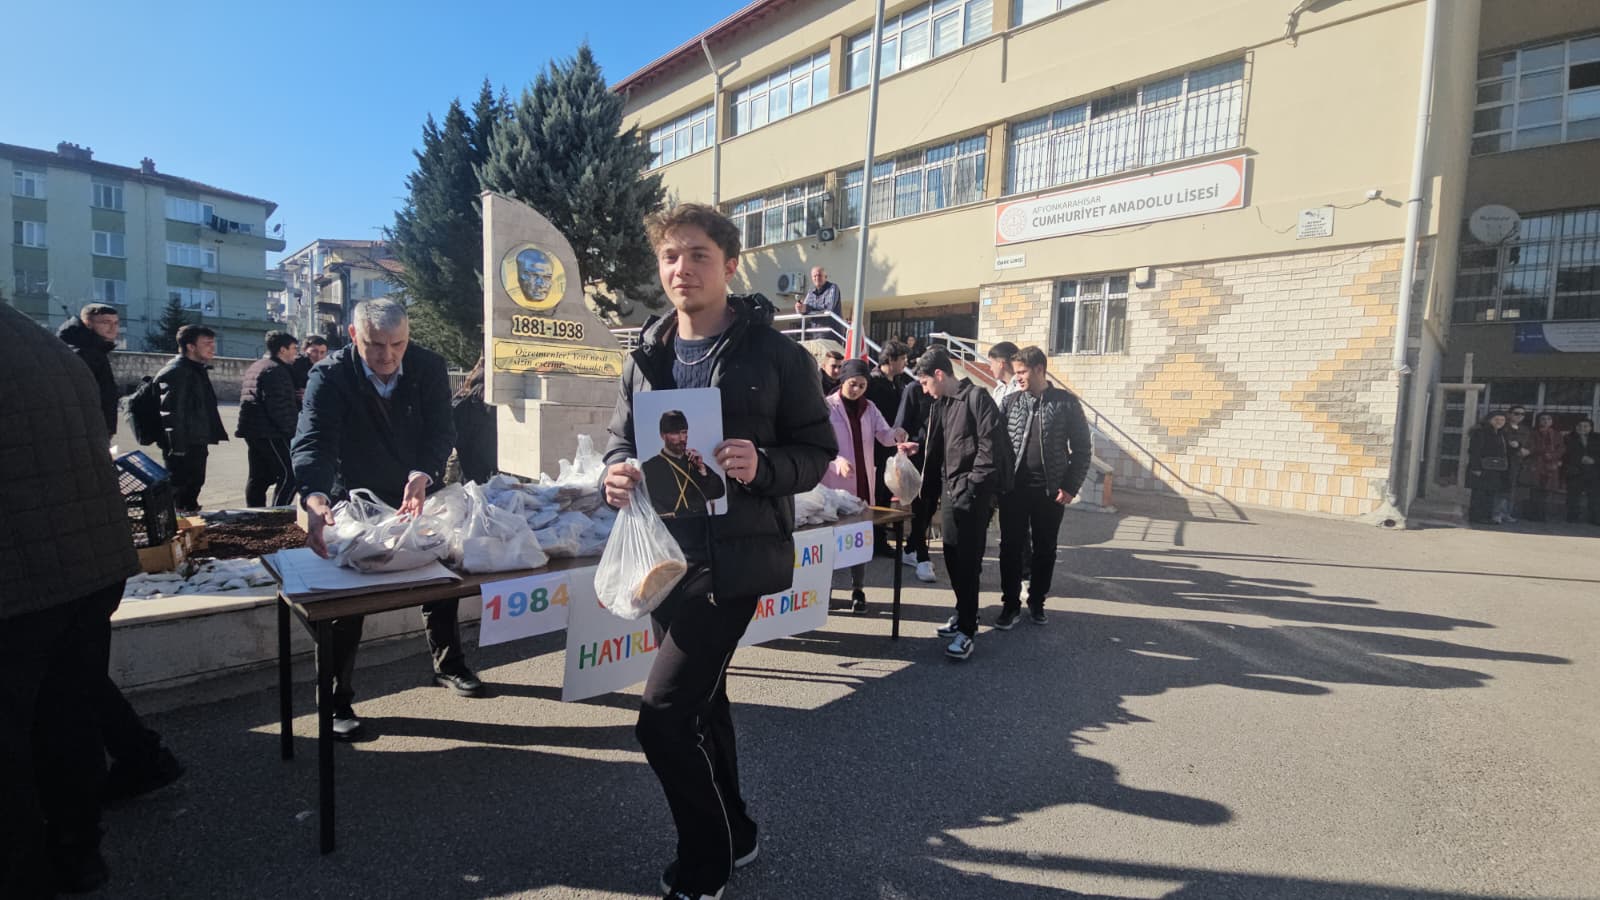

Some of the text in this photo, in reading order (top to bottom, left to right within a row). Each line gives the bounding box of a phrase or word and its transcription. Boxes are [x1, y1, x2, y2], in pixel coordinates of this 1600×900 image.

[1032, 183, 1219, 228] CUMHURİYET ANADOLU LİSESİ
[514, 317, 583, 340] 1881-1938
[486, 583, 569, 620] 1984
